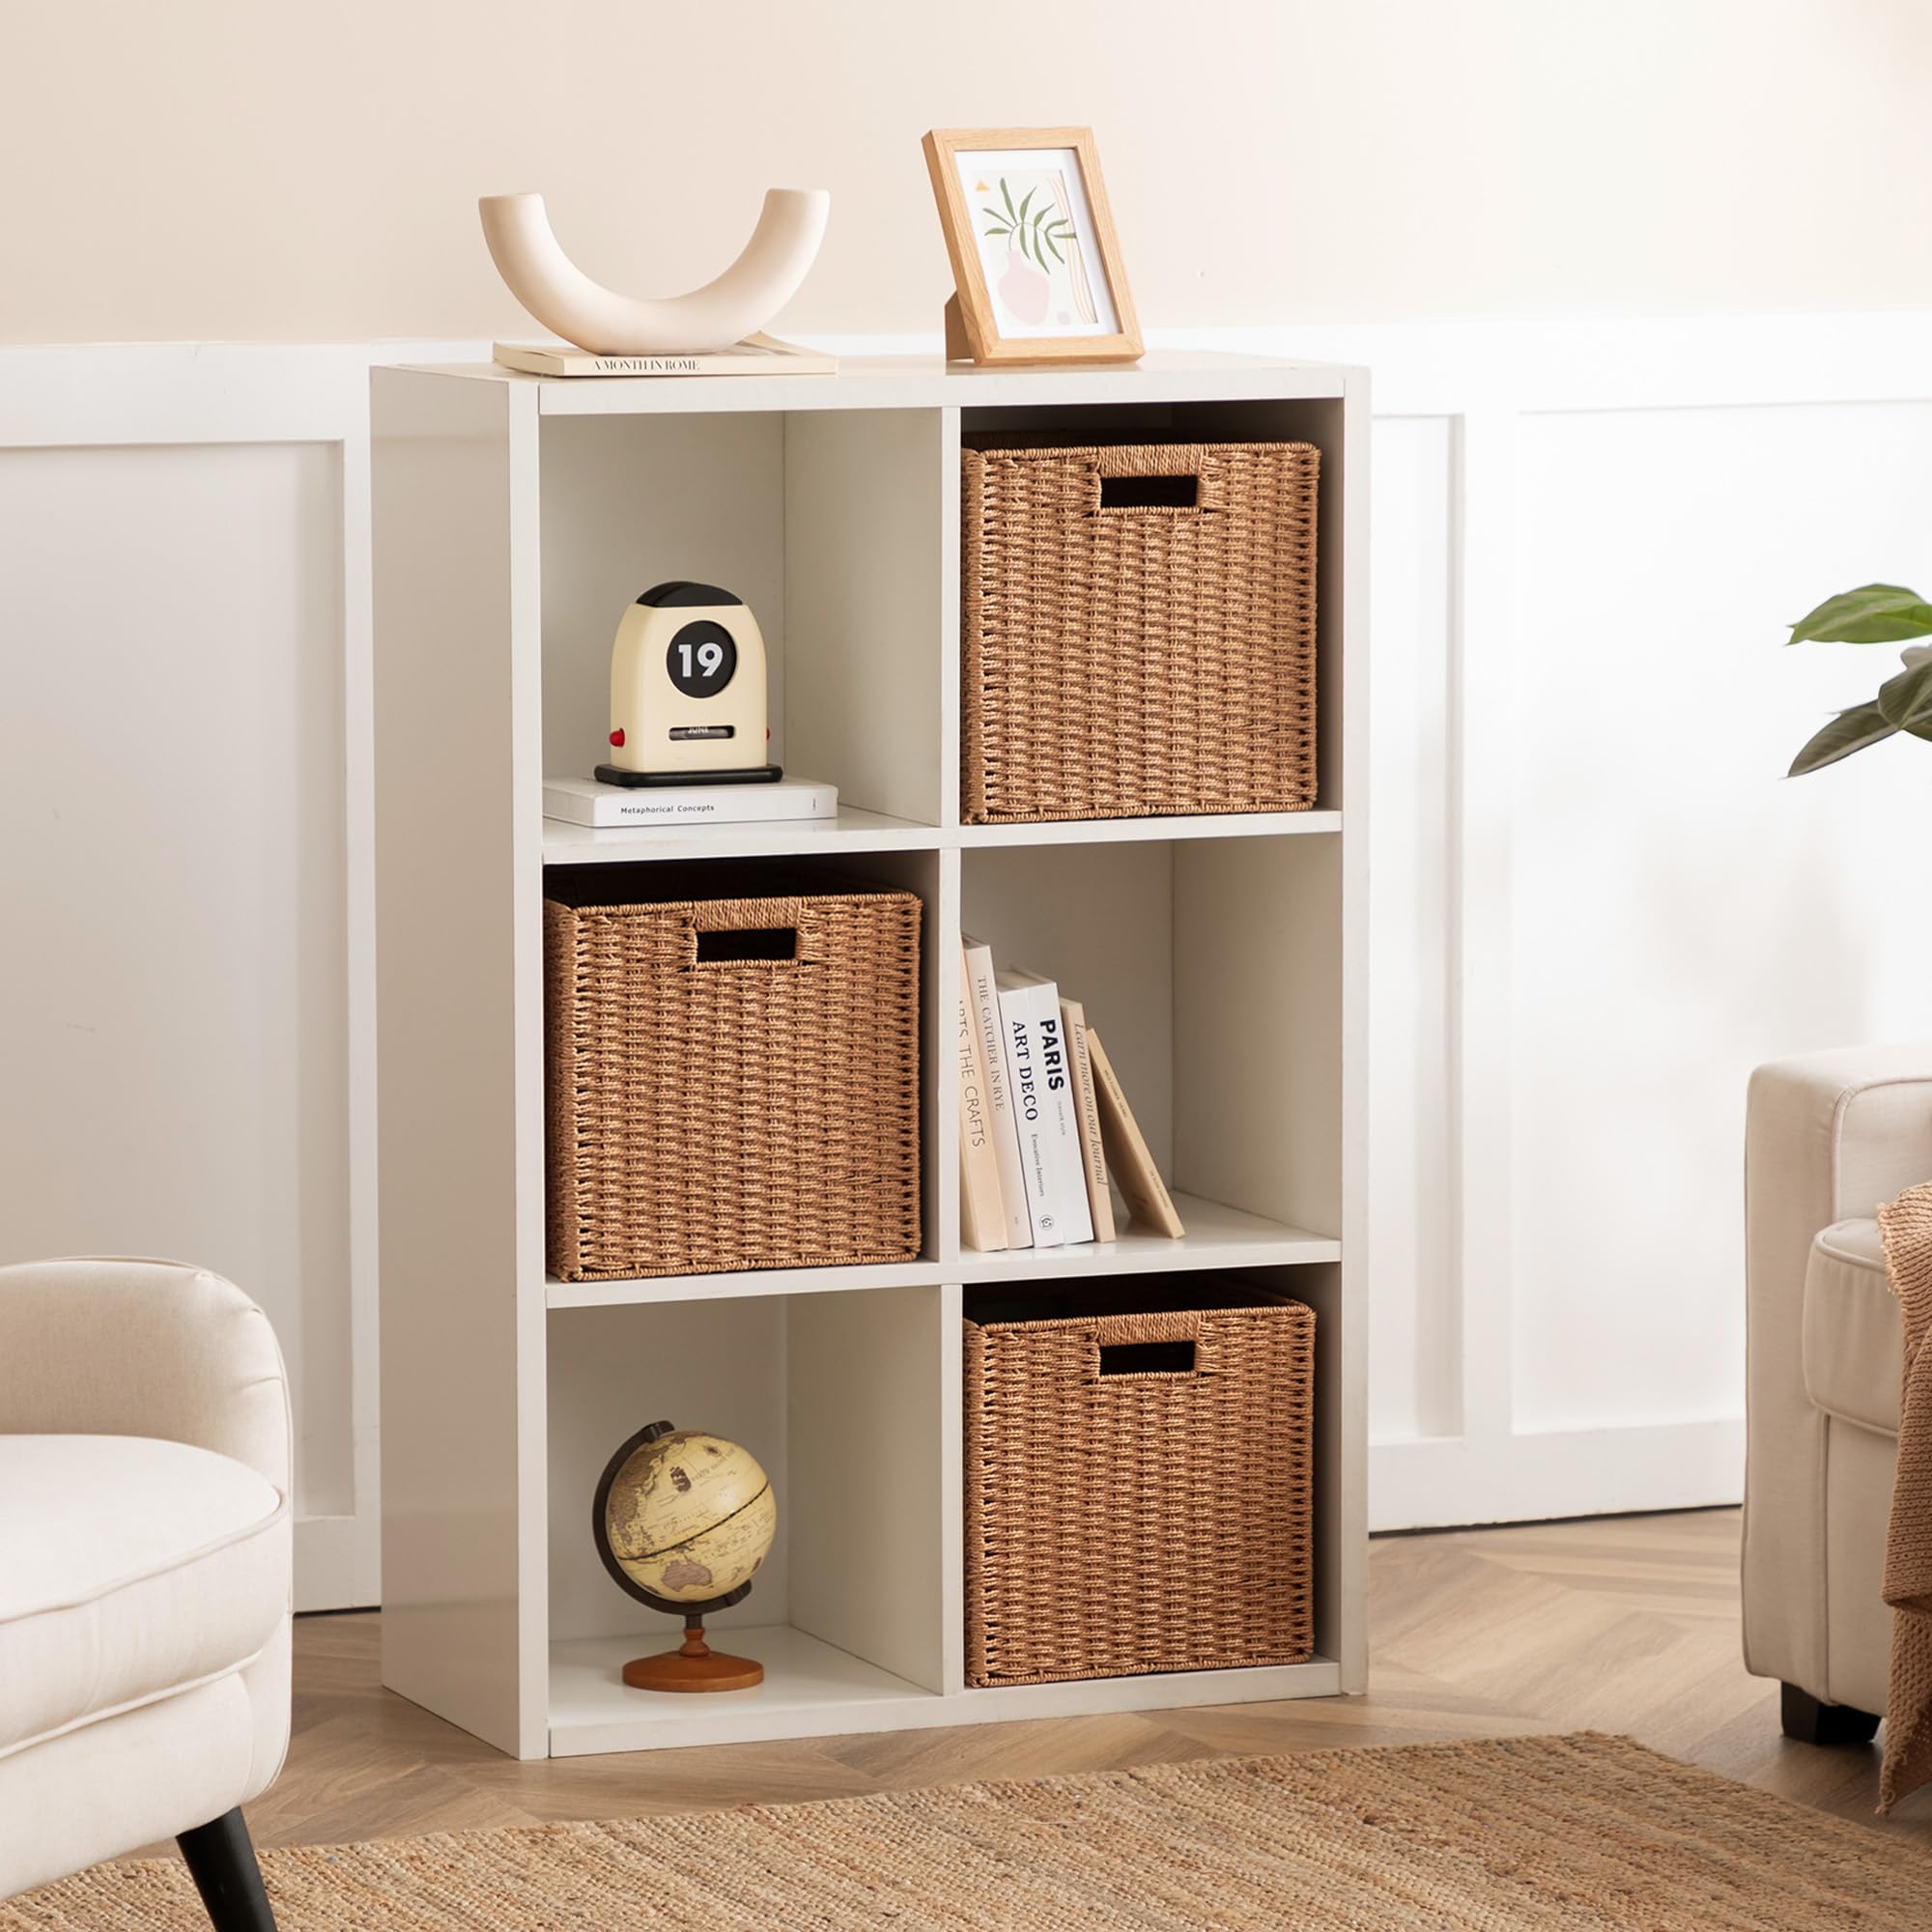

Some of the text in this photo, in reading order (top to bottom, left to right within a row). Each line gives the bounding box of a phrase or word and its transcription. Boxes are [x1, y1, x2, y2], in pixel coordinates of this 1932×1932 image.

[593, 360, 701, 371] A MONTH IN ROME
[678, 642, 724, 677] 19
[620, 804, 715, 815] Metaphorical Concepts
[958, 1043, 976, 1079] THE
[978, 978, 1006, 1112] THE CATCHER IN RYE
[1012, 1021, 1039, 1121] ART DECO
[1039, 1019, 1065, 1092] PARIS
[964, 1085, 986, 1148] CRAFTS
[1074, 1022, 1109, 1186] Learn more on our Journal
